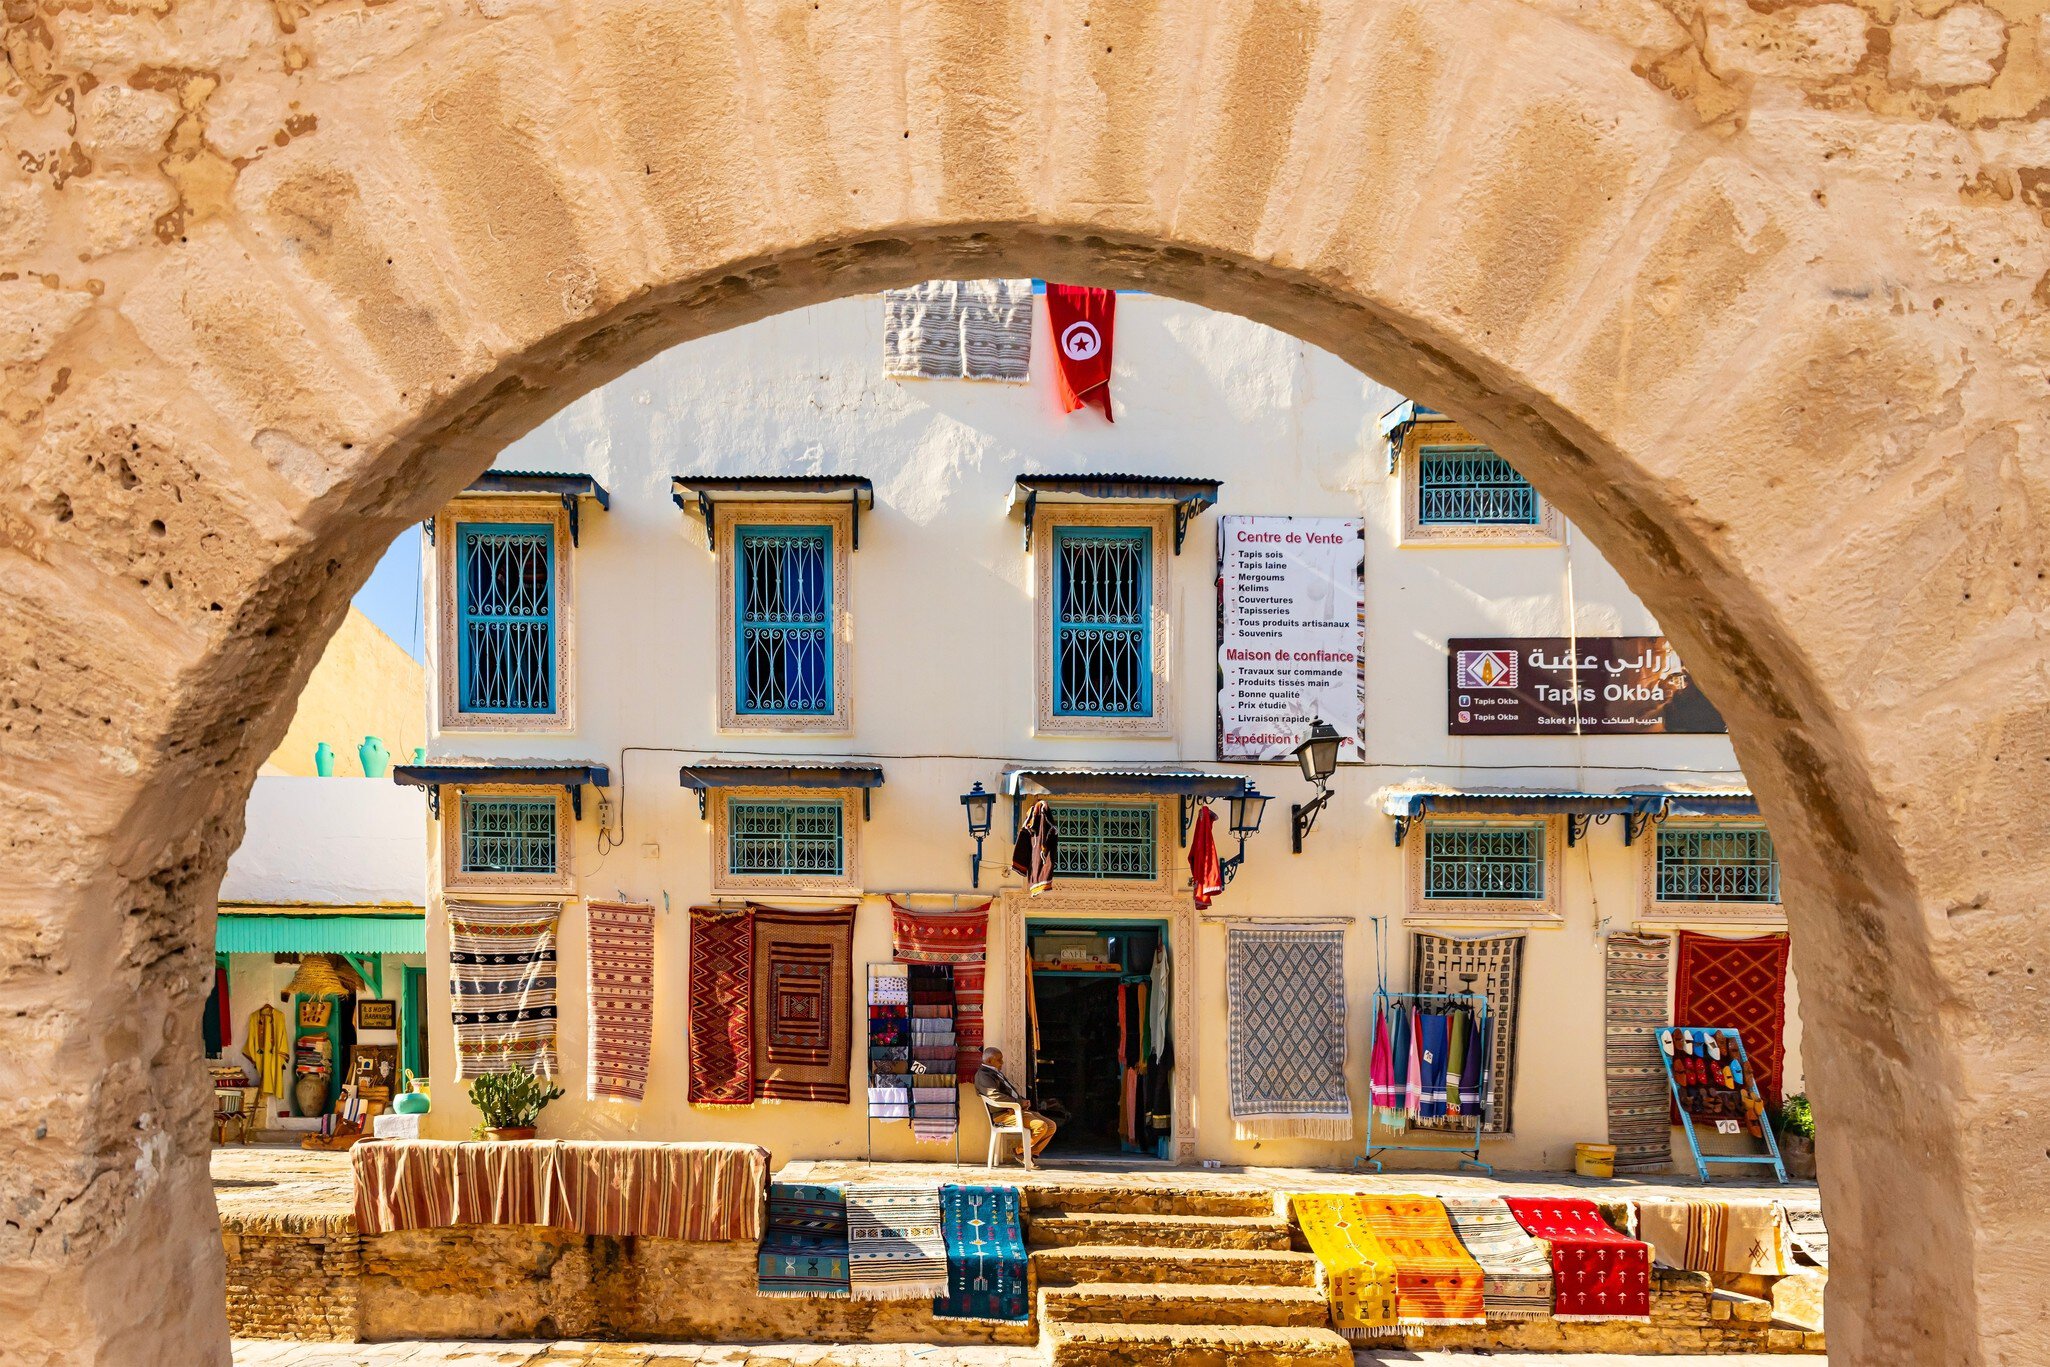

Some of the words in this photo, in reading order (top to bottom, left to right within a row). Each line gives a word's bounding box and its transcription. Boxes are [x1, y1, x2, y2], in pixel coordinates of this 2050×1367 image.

[1237, 531, 1281, 542] Centre
[1286, 532, 1301, 543] de
[1306, 533, 1343, 544] Vente
[1239, 550, 1262, 559] Tapis
[1239, 562, 1262, 570] Tapis
[1239, 573, 1285, 582] Mergoums
[1239, 584, 1268, 592] Kelims
[1239, 596, 1293, 604] Couvertures
[1239, 607, 1289, 615] Tapisseries
[1263, 619, 1299, 627] produits
[1227, 649, 1270, 661] Maison
[1275, 649, 1289, 661] de
[1294, 650, 1353, 662] confiance
[1528, 648, 1598, 673] عقبة
[1239, 667, 1274, 675] Travaux
[1239, 678, 1275, 686] Produits
[1239, 690, 1266, 698] Bonne
[1270, 691, 1299, 699] qualité
[1535, 685, 1596, 705] Tapis
[1604, 684, 1664, 701] Okba
[1474, 698, 1495, 706] Tapis
[1239, 715, 1279, 724] Livraison
[1282, 715, 1310, 724] rapide
[1474, 714, 1495, 722] Tapis
[1538, 717, 1566, 725] Saket
[1226, 733, 1290, 746] Expédition
